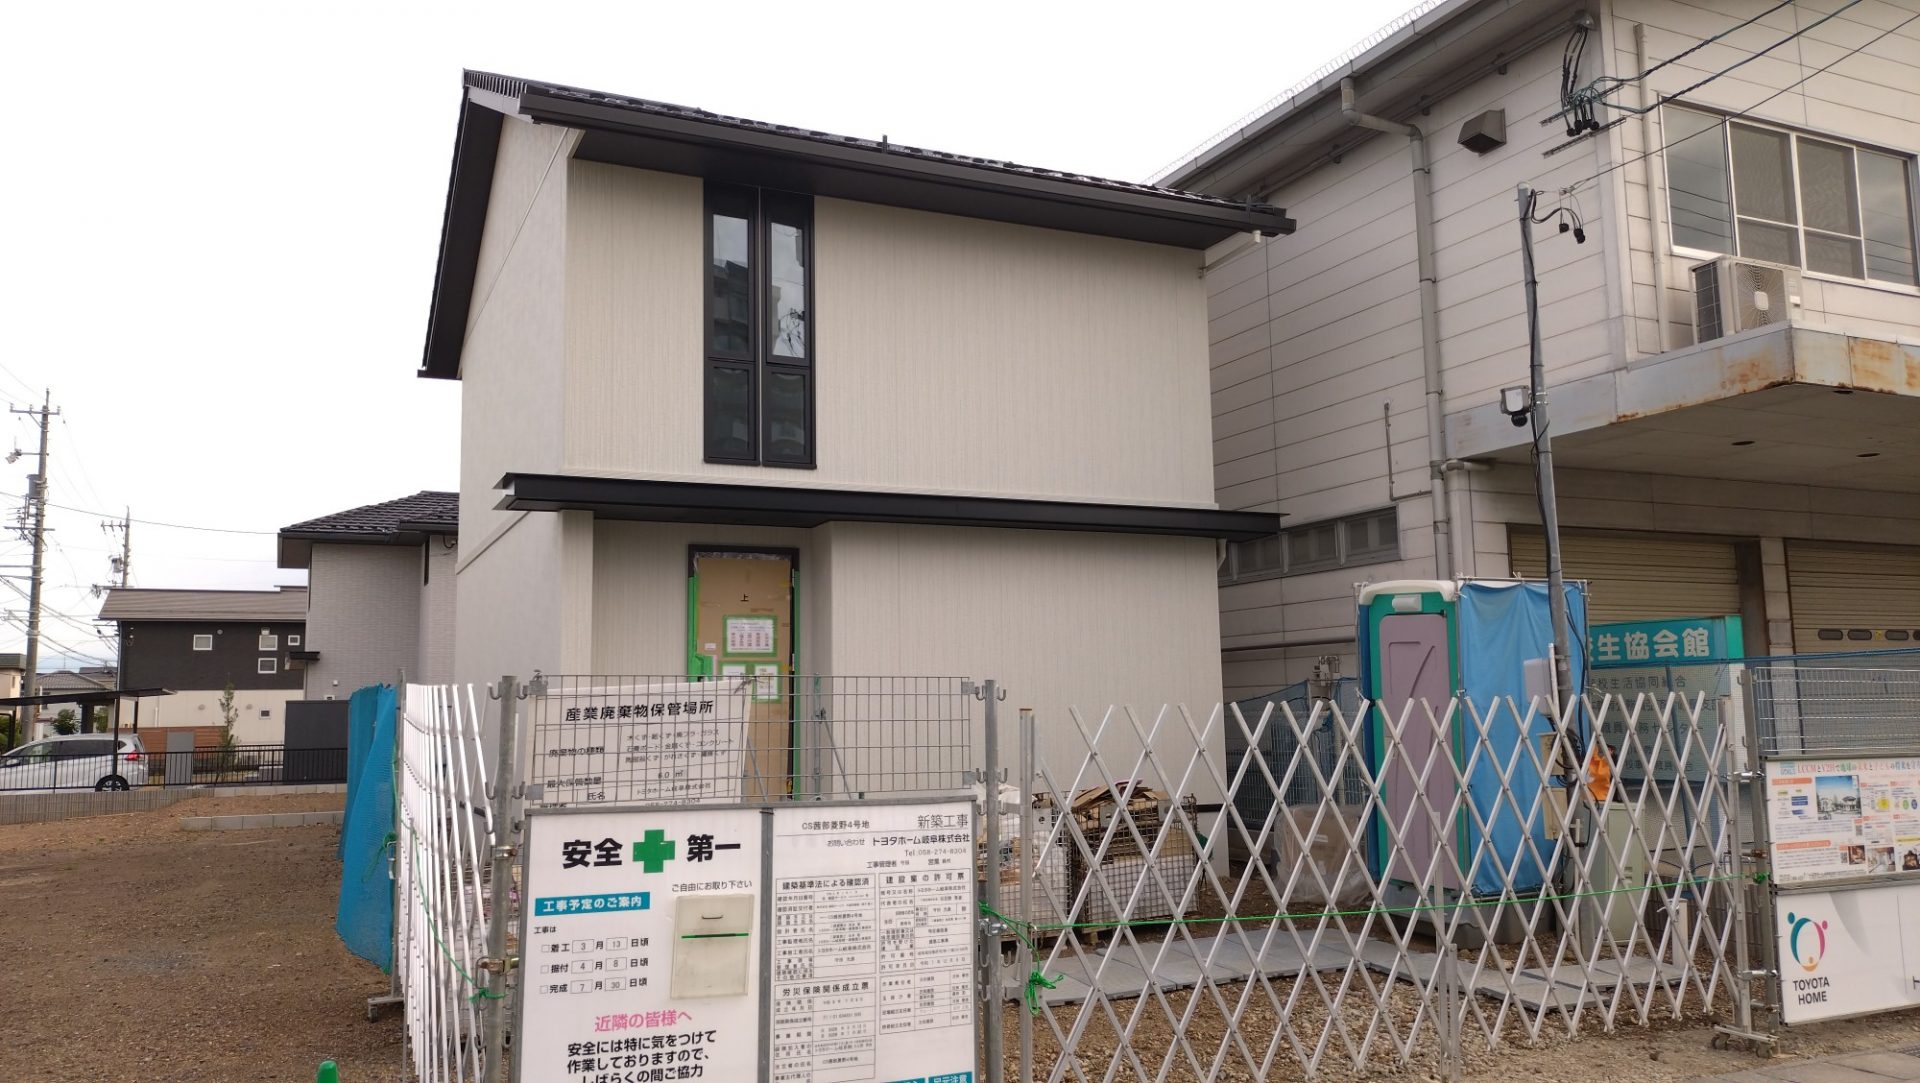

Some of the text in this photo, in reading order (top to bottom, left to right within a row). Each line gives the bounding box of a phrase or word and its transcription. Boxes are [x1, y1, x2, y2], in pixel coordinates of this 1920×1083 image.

[740, 594, 749, 602] 上
[1588, 627, 1710, 662] 生協会館
[565, 700, 714, 722] 産業廃棄物保管場所
[587, 792, 606, 800] 氏名
[917, 814, 969, 829] 新築工事
[872, 833, 970, 846] トヨタホーム岐阜株式会社
[562, 834, 741, 869] 安全 第一
[672, 880, 752, 893] ご自由にお取り下さい
[542, 896, 642, 912] 工事予定のご案内
[534, 926, 556, 934] 工事は
[550, 938, 649, 953] 着工 3 月 13 日頃
[550, 958, 649, 974] 据付 4 月 8 日頃
[550, 978, 648, 994] 完成 7 月 30 日頃
[1793, 976, 1830, 992] TOYOTA
[1798, 991, 1828, 1005] HOME
[594, 1009, 692, 1033] 近隣の皆様へ
[567, 1030, 718, 1058] 安全には特に気をつけて
[566, 1046, 711, 1075] 作業しておりますので、
